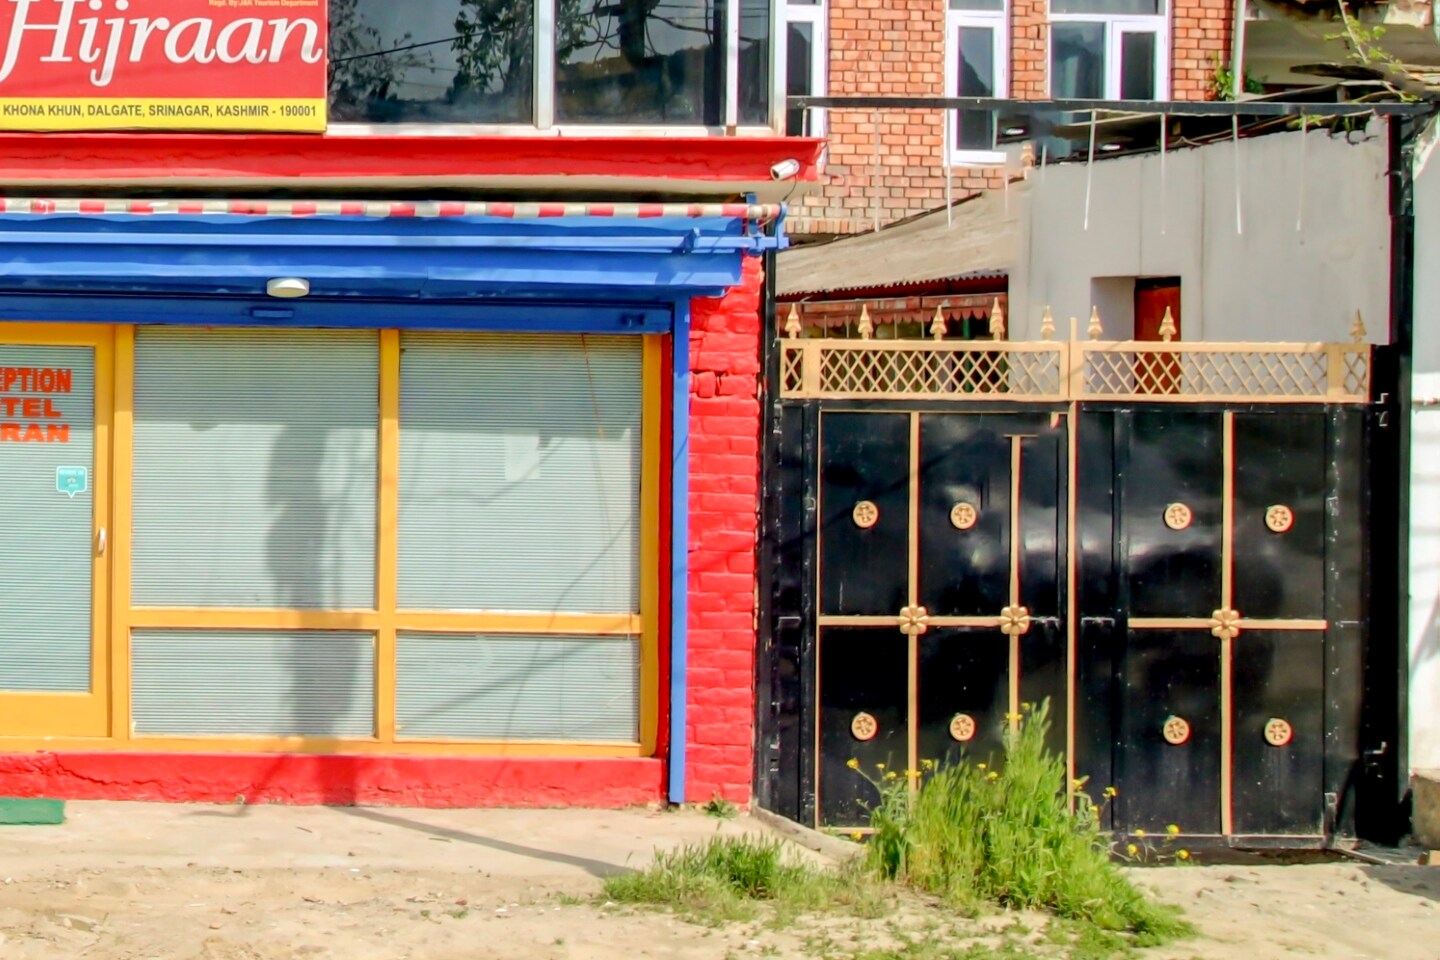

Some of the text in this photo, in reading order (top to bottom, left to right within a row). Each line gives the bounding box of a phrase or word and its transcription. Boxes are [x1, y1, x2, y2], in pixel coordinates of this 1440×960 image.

[254, 0, 280, 7] Tourism
[280, 0, 319, 7] Department
[3, 104, 45, 116] KHONA
[48, 105, 85, 117] KHUN,
[87, 105, 145, 118] DALGATE,
[148, 105, 213, 118] SRINAGAR,
[216, 105, 269, 117] KASHMIR
[280, 105, 316, 117] 190001
